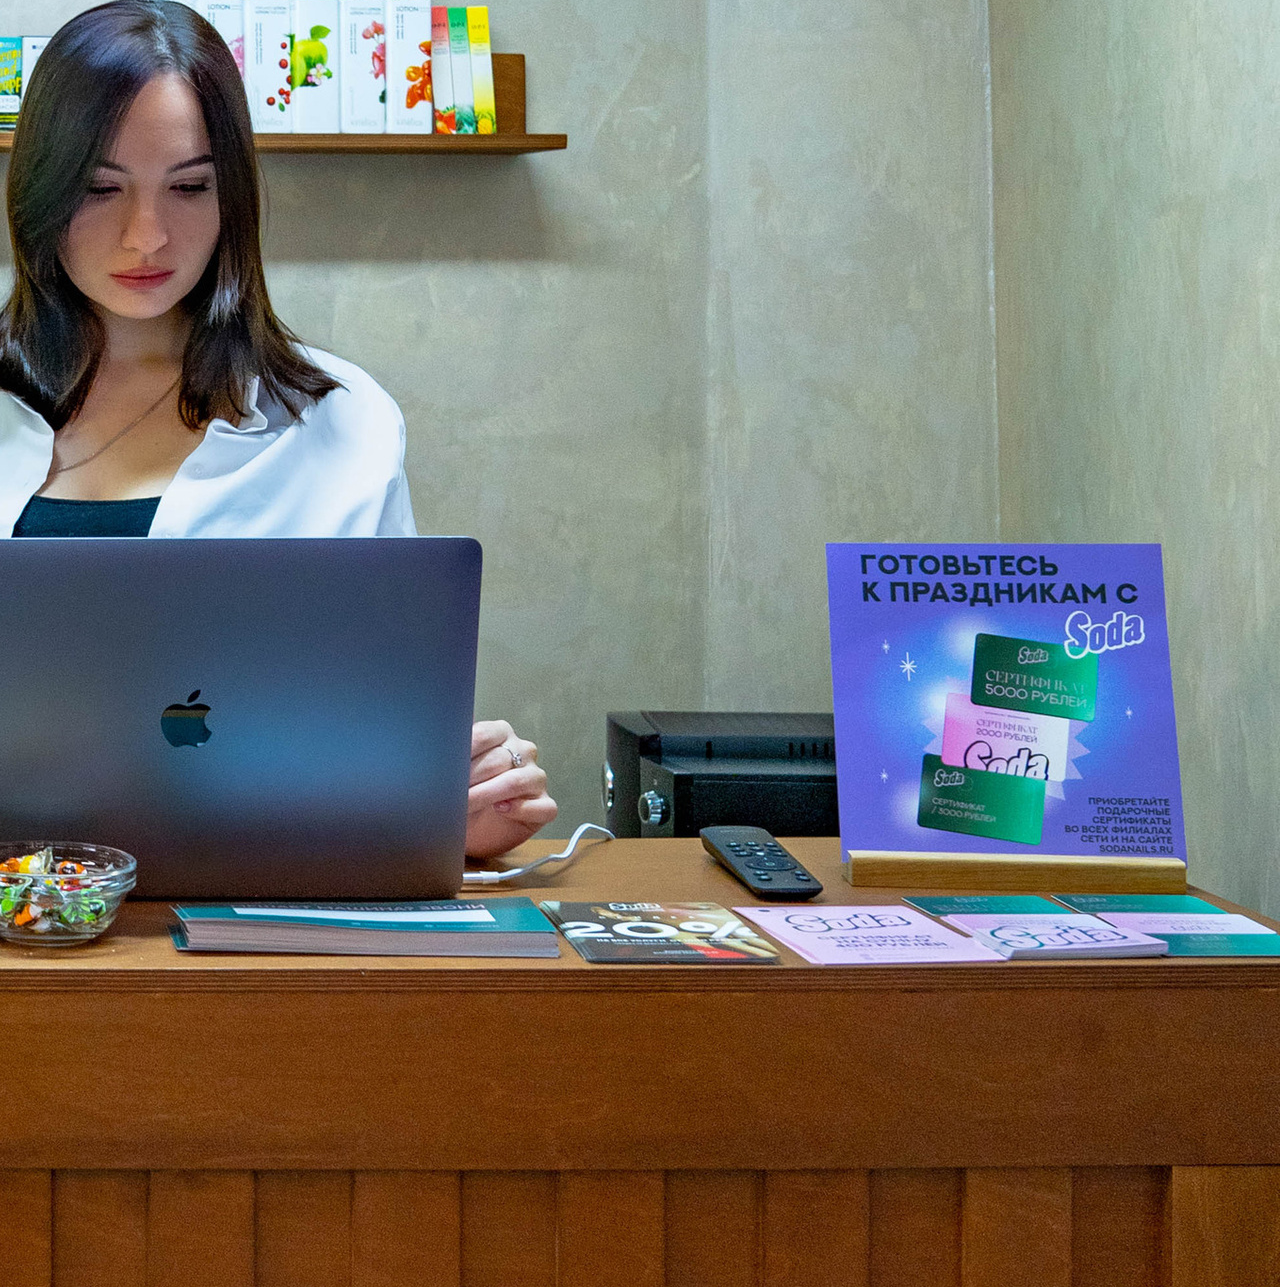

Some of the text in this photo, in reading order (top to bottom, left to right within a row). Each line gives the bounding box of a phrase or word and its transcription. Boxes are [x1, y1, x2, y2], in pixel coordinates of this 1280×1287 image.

[860, 554, 1058, 576] ГОТОВЬТЕСЬ
[862, 582, 1138, 606] К ПРАЗДНИКАМ С
[1064, 611, 1145, 659] Soda
[1018, 646, 1049, 664] Soda
[985, 669, 1085, 694] СЕРТИФИКАТ
[985, 683, 1087, 708] 5000 РУБЛЕЙ
[976, 719, 1038, 734] СЕРТИФИКАТ
[976, 728, 1037, 743] 2000 РУБЛЕЙ
[964, 740, 1049, 780] Soda
[934, 769, 965, 787] Soda
[932, 797, 985, 811] СЕРТИФИКАТ
[1088, 797, 1170, 806] ПРИОБРЕТАЙТЕ
[1092, 816, 1171, 825] СЕРТИФИКАТЫ
[1098, 807, 1170, 816] ПОДАРОЧНЫЕ
[1065, 825, 1172, 835] ВО ВСЕХ ФИЛИАЛАХ
[1080, 835, 1108, 843] СЕТИ
[1111, 835, 1119, 843] И
[1138, 835, 1173, 844] САЙТЕ
[1099, 844, 1174, 854] SODANAILS.RU
[418, 903, 486, 911] ЗВОНИ
[560, 920, 759, 939] 20%
[785, 913, 912, 933] Soda
[990, 925, 1128, 948] Soda
